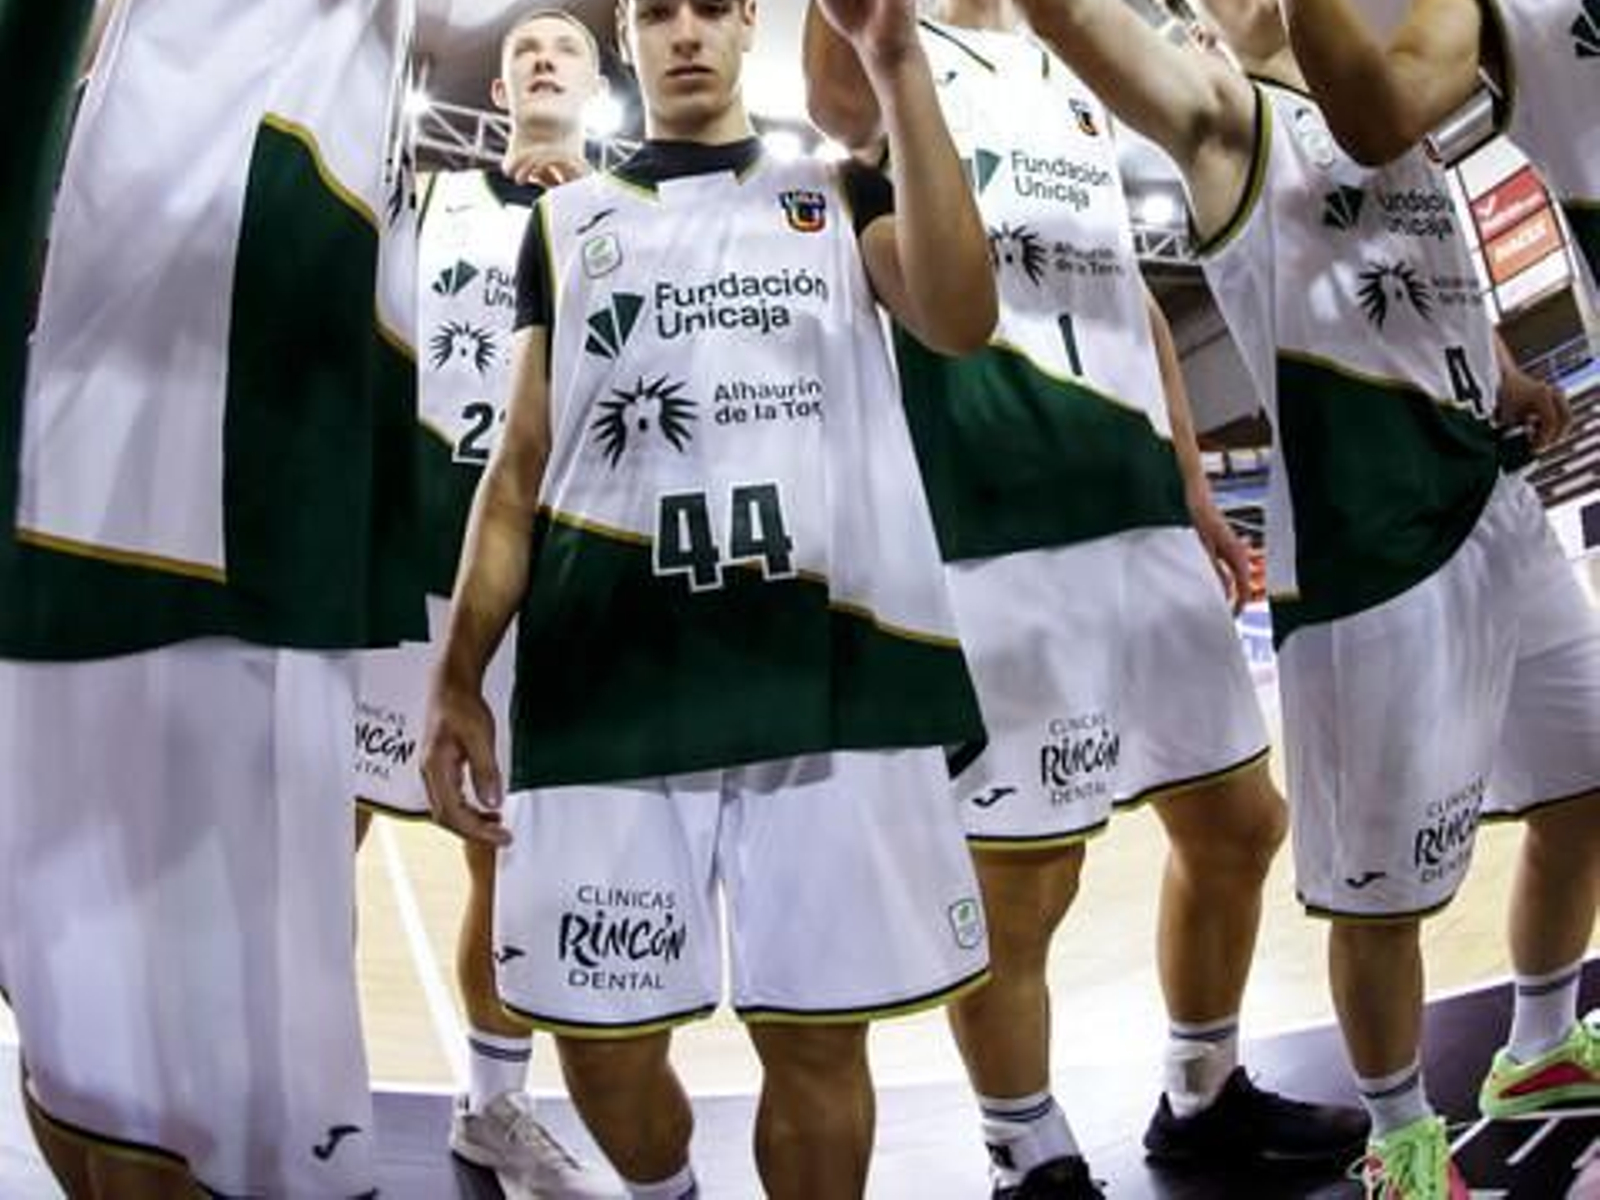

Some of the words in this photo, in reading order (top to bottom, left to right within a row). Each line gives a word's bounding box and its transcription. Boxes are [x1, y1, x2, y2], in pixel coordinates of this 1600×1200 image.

[655, 268, 829, 310] Fundación
[657, 299, 790, 340] Unicaja
[456, 402, 506, 462] 2
[714, 404, 747, 426] de
[754, 403, 777, 421] la
[654, 483, 797, 591] 44
[567, 969, 666, 990] DENTAL
